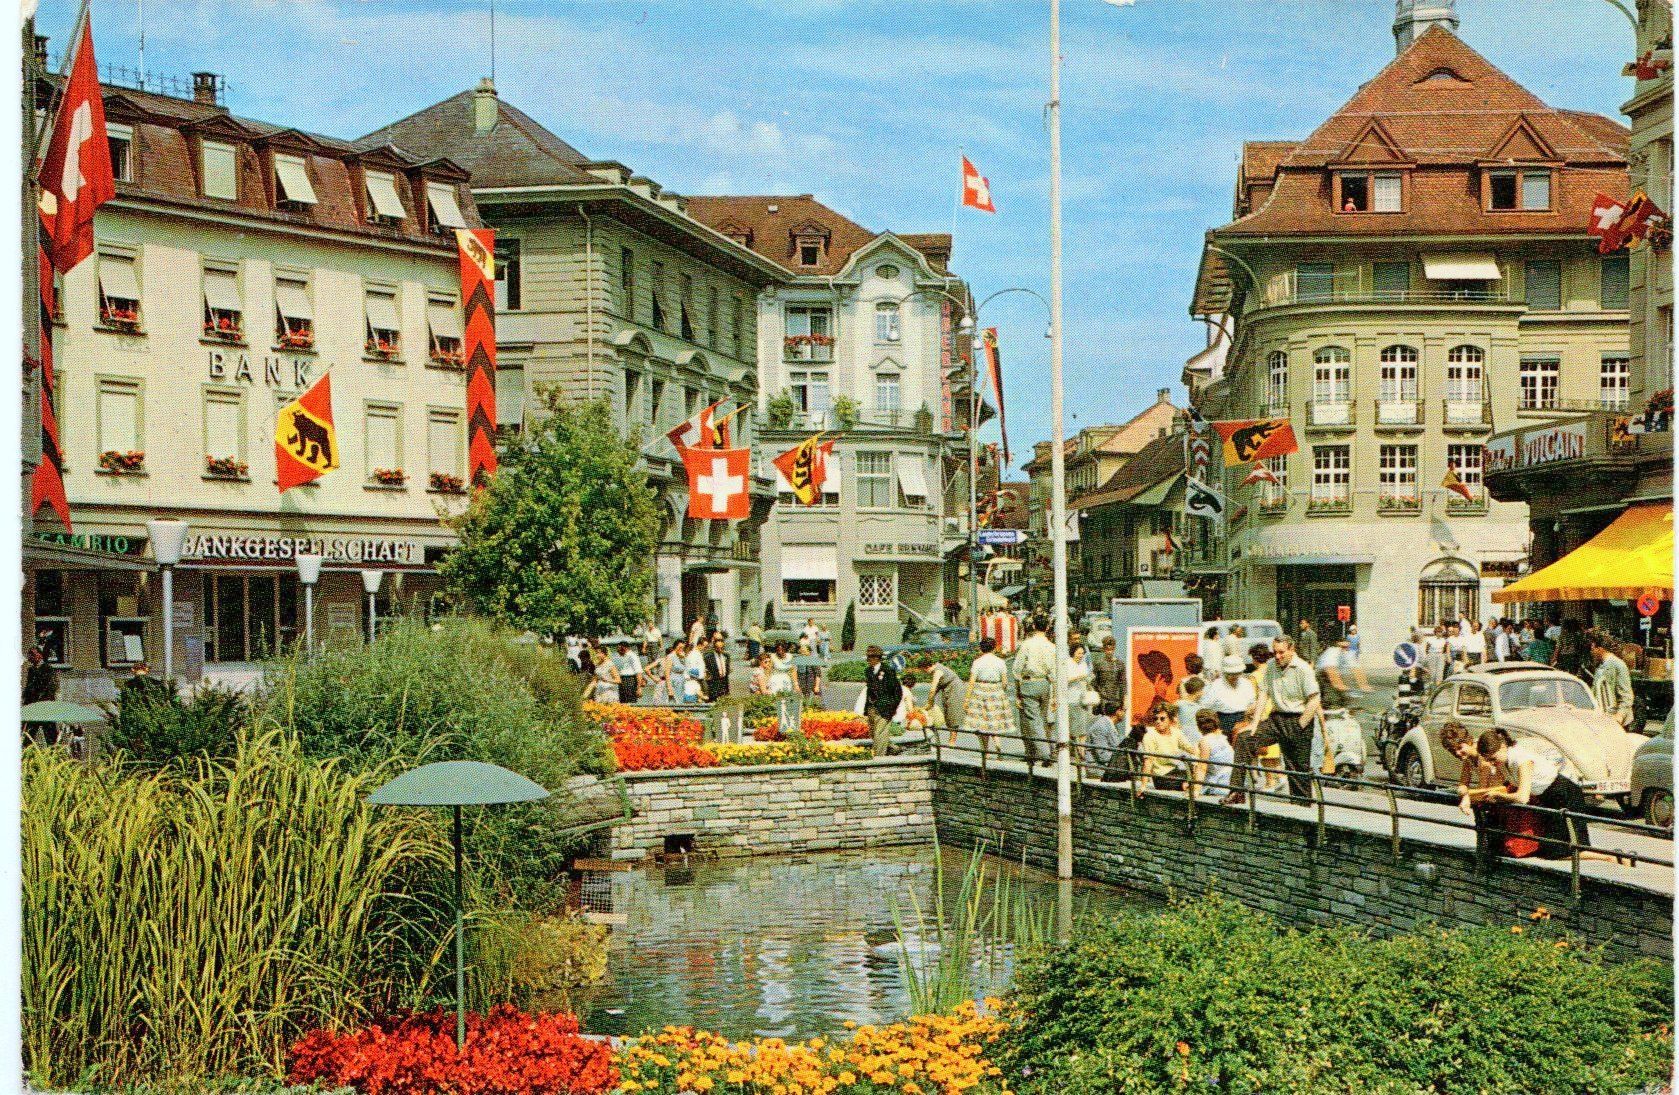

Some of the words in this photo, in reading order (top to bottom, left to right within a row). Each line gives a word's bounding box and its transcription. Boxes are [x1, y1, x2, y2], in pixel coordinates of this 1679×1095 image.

[209, 351, 312, 388] BANK
[1523, 427, 1585, 466] VULCAIN
[183, 535, 417, 562] BANKGESELLSCHAFT
